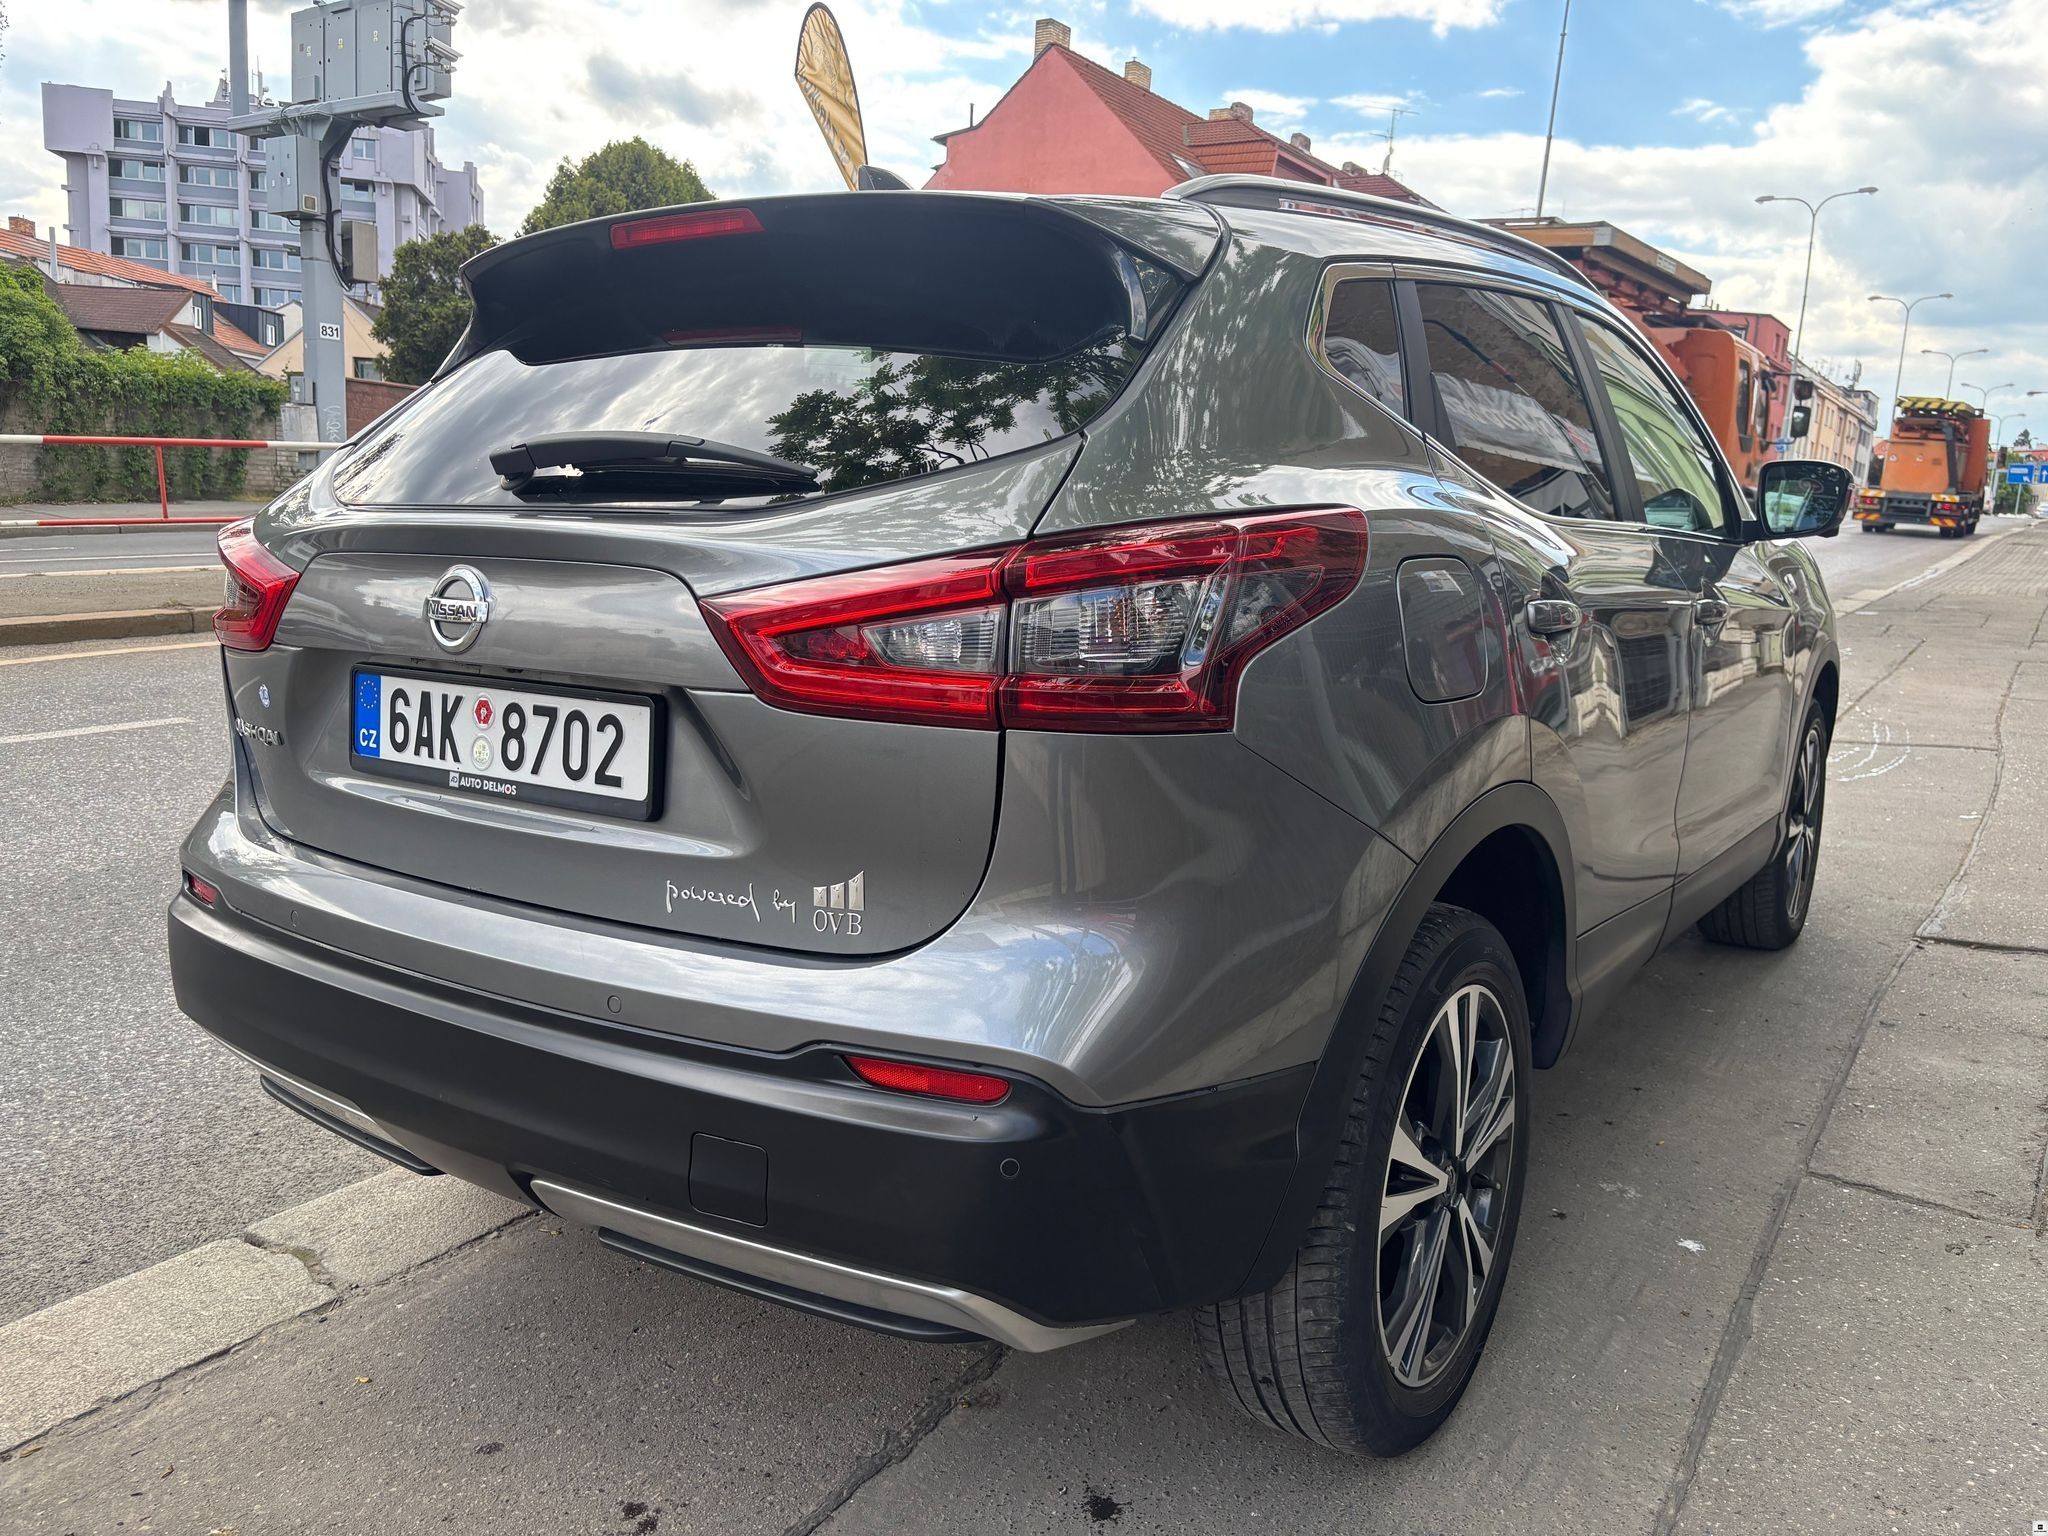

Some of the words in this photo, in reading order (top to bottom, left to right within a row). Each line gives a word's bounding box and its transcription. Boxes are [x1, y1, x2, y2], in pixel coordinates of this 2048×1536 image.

[321, 325, 339, 338] 831
[428, 600, 478, 618] NISSAN
[359, 728, 377, 748] CZ
[389, 687, 464, 763] 6AK
[501, 702, 624, 788] 8702
[460, 777, 482, 789] AUTO
[483, 780, 517, 796] DELMOS
[665, 880, 761, 923] powered
[773, 889, 796, 924] by
[813, 909, 862, 936] OVB
